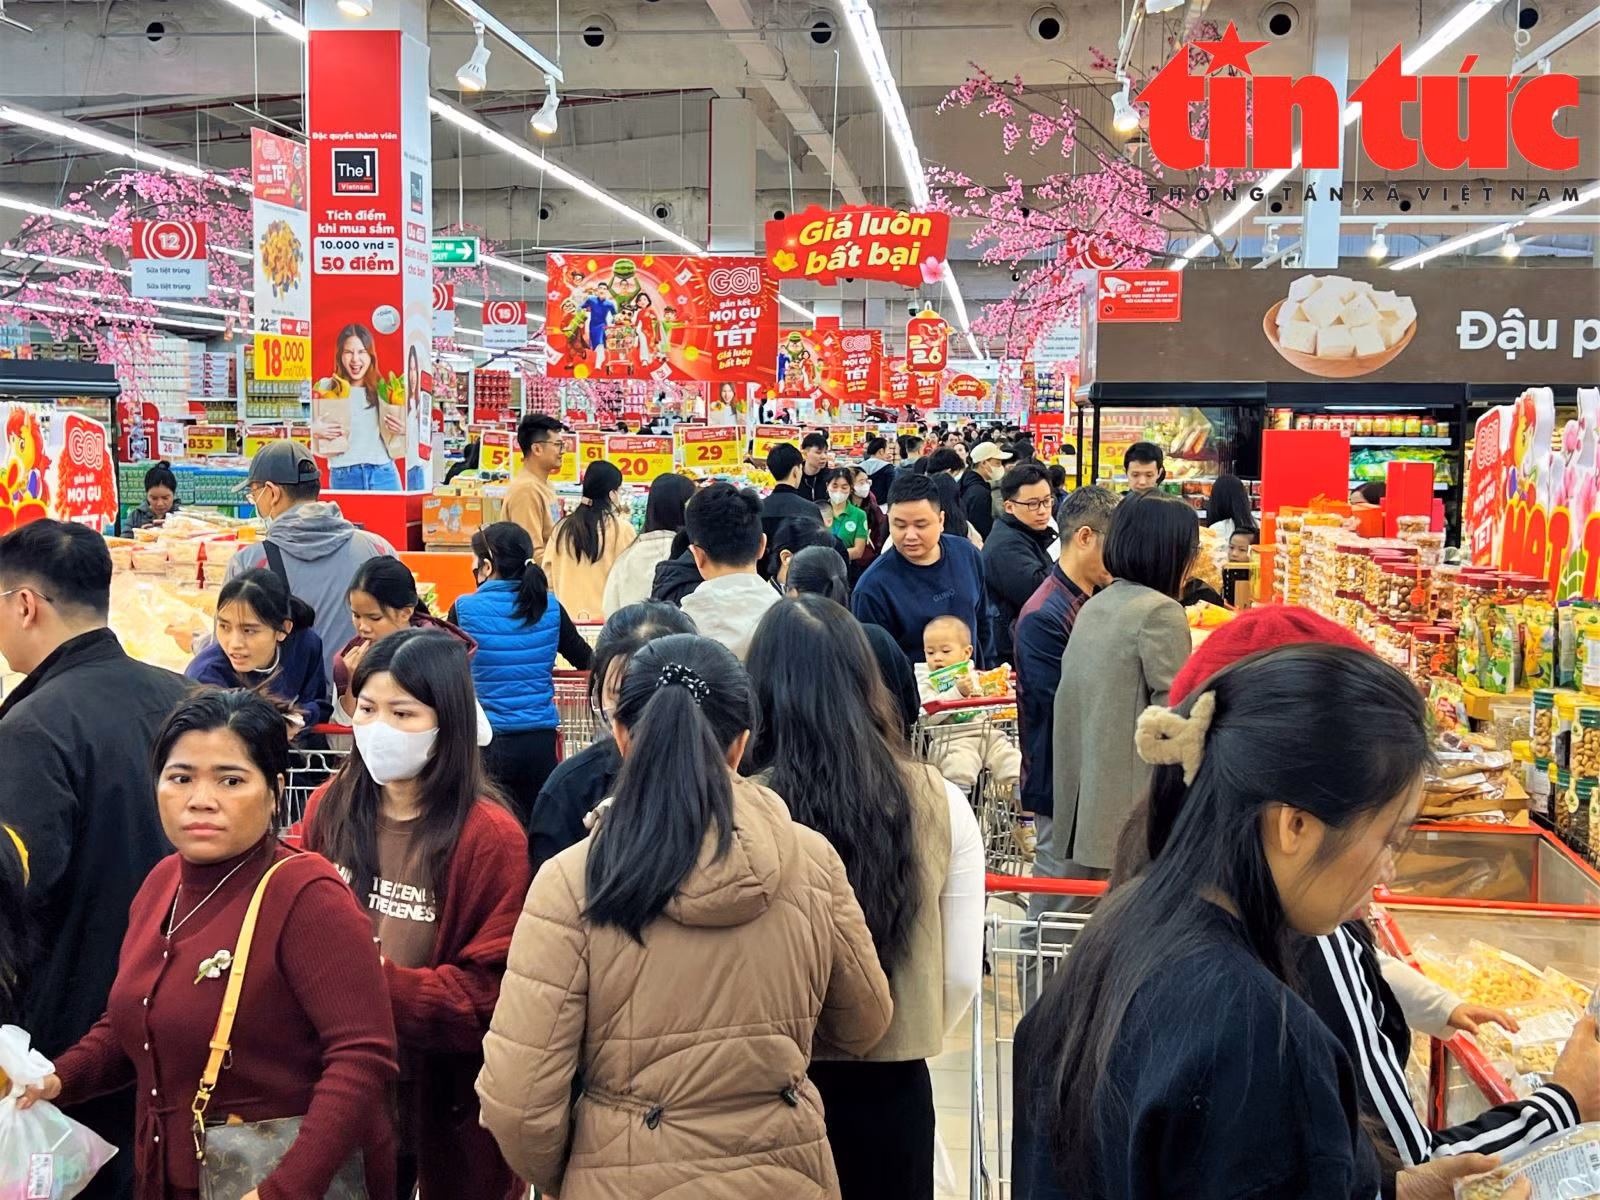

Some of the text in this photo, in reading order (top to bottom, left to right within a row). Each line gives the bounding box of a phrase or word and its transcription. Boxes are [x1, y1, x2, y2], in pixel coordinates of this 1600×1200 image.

[337, 163, 364, 177] The
[325, 209, 353, 221] Tích
[317, 222, 395, 234] khi mua sắm
[799, 211, 932, 246] Giá luôn
[158, 232, 181, 250] 12
[320, 240, 360, 249] 10.000
[363, 240, 384, 249] vnd
[321, 252, 394, 271] 50 điểm
[804, 241, 921, 276] bất bại
[707, 266, 761, 296] GO!
[709, 306, 761, 324] MỌI GU
[260, 317, 270, 332] 22
[713, 321, 757, 348] TẾT
[1456, 307, 1600, 361] Đậu p
[832, 434, 845, 444] 67
[68, 426, 104, 471] GO!
[697, 445, 723, 461] 29
[617, 457, 649, 476] 20
[67, 485, 102, 507] MỌI GU
